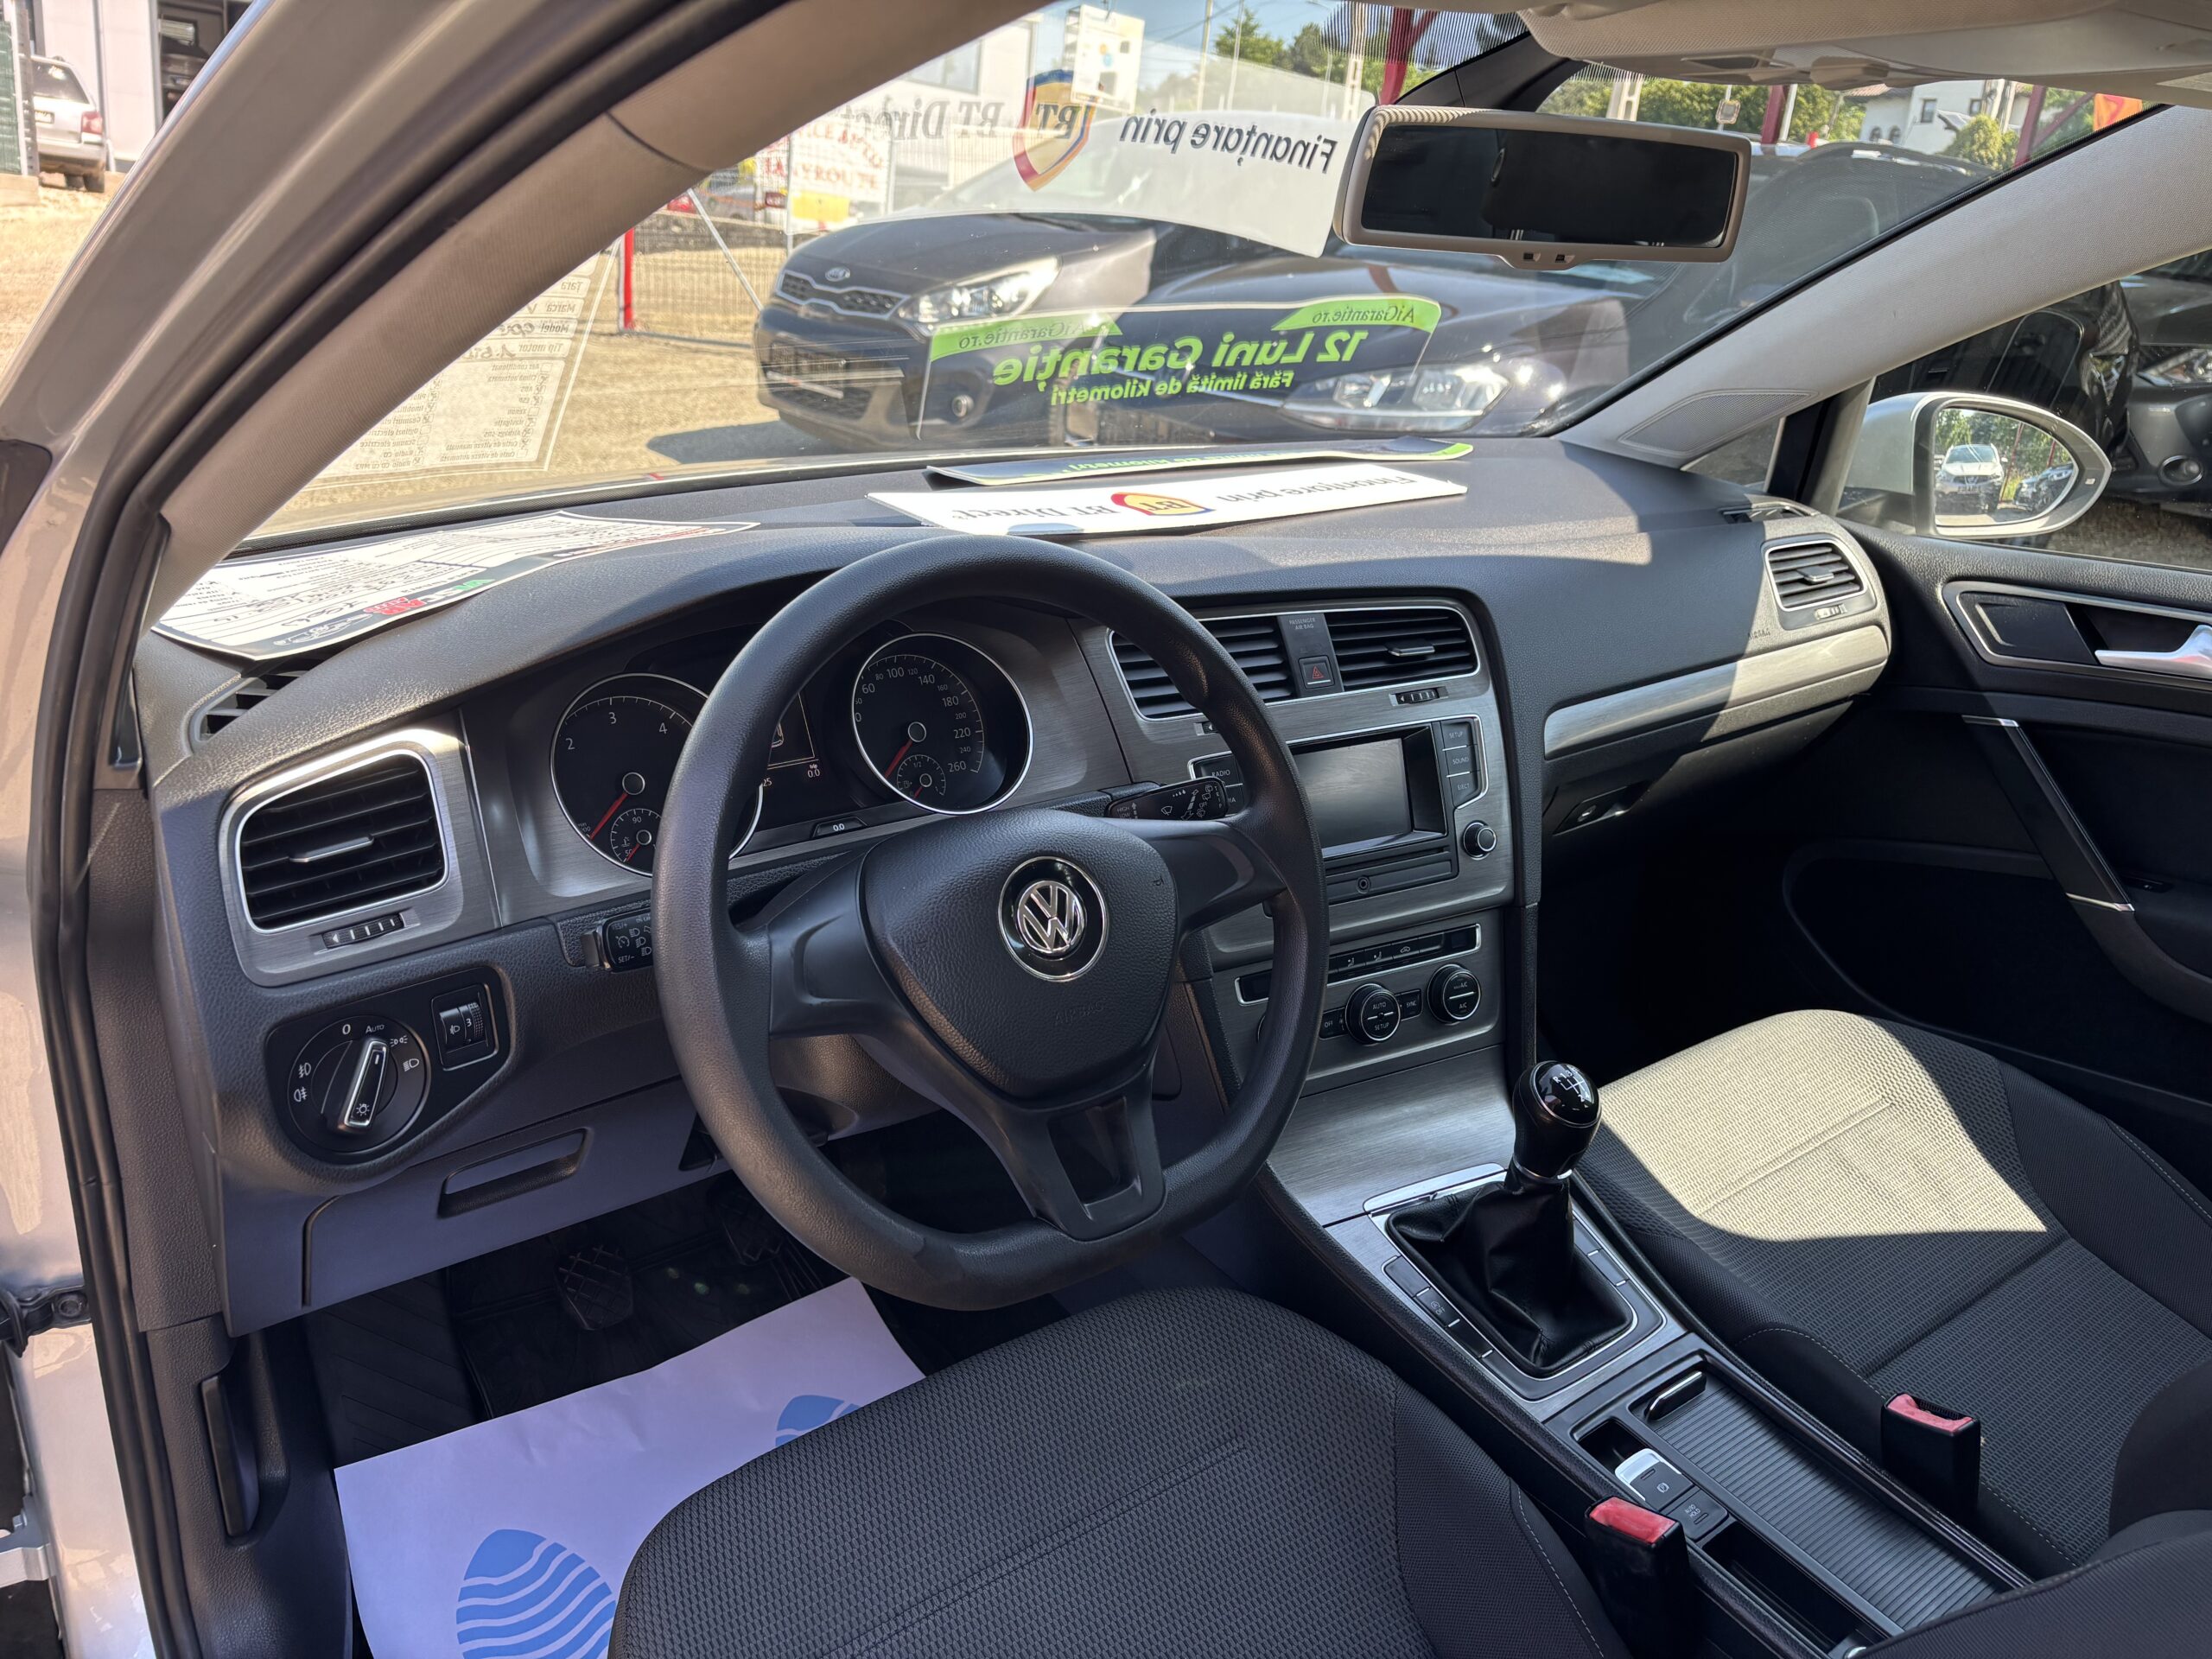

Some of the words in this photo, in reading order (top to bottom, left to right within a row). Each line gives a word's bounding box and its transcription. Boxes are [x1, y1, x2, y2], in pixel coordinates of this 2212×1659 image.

[1281, 474, 1417, 496] Finanțare
[1216, 488, 1282, 504] prin
[1070, 505, 1121, 516] BT
[1141, 500, 1191, 512] BT
[959, 506, 1072, 521] Direct
[887, 666, 905, 678] 100
[918, 674, 936, 685] 140
[862, 683, 875, 694] 60
[942, 696, 959, 707] 180
[608, 711, 617, 724] 3
[659, 722, 668, 734] 4
[953, 727, 971, 739] 220
[566, 738, 575, 750] 2
[948, 760, 967, 772] 260
[1452, 756, 1470, 765] SOUND
[807, 769, 821, 779] 0.0
[1211, 769, 1230, 778] RADIO
[763, 778, 772, 786] 25
[832, 823, 845, 831] 0.0
[1372, 1001, 1387, 1010] AUTO
[466, 1018, 473, 1027] 3
[1374, 1022, 1389, 1031] SETUP
[342, 1024, 351, 1035] 0
[1578, 1094, 1586, 1103] 2
[1685, 1503, 1696, 1515] AUTO
[1689, 1508, 1701, 1519] HOLD
